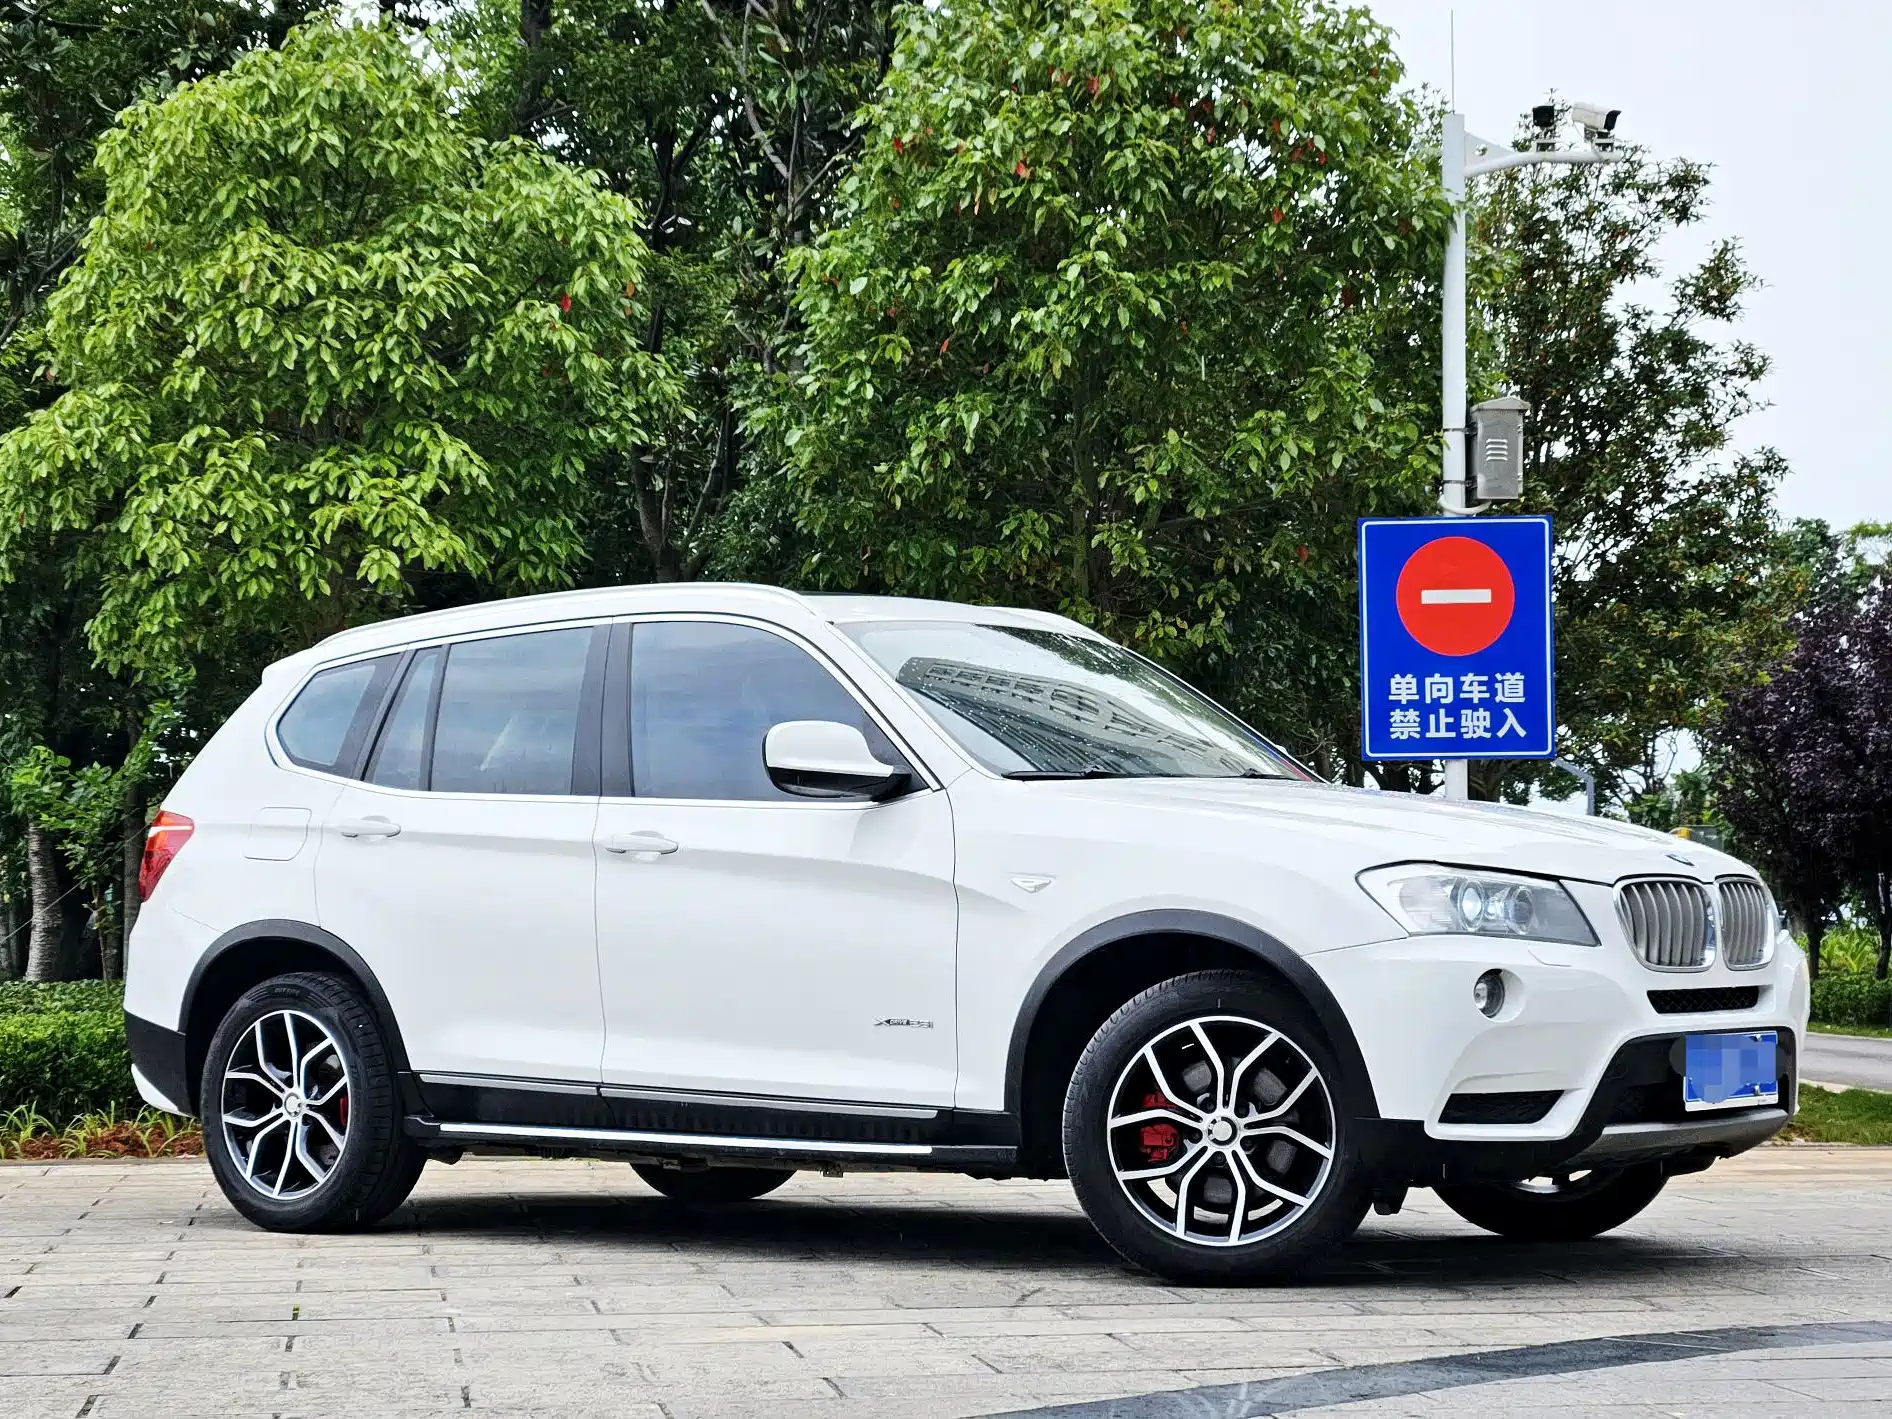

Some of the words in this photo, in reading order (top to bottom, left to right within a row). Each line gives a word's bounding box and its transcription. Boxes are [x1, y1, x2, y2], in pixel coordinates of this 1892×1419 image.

[1388, 672, 1526, 705] 单向车道
[1389, 707, 1527, 740] 禁止驶入
